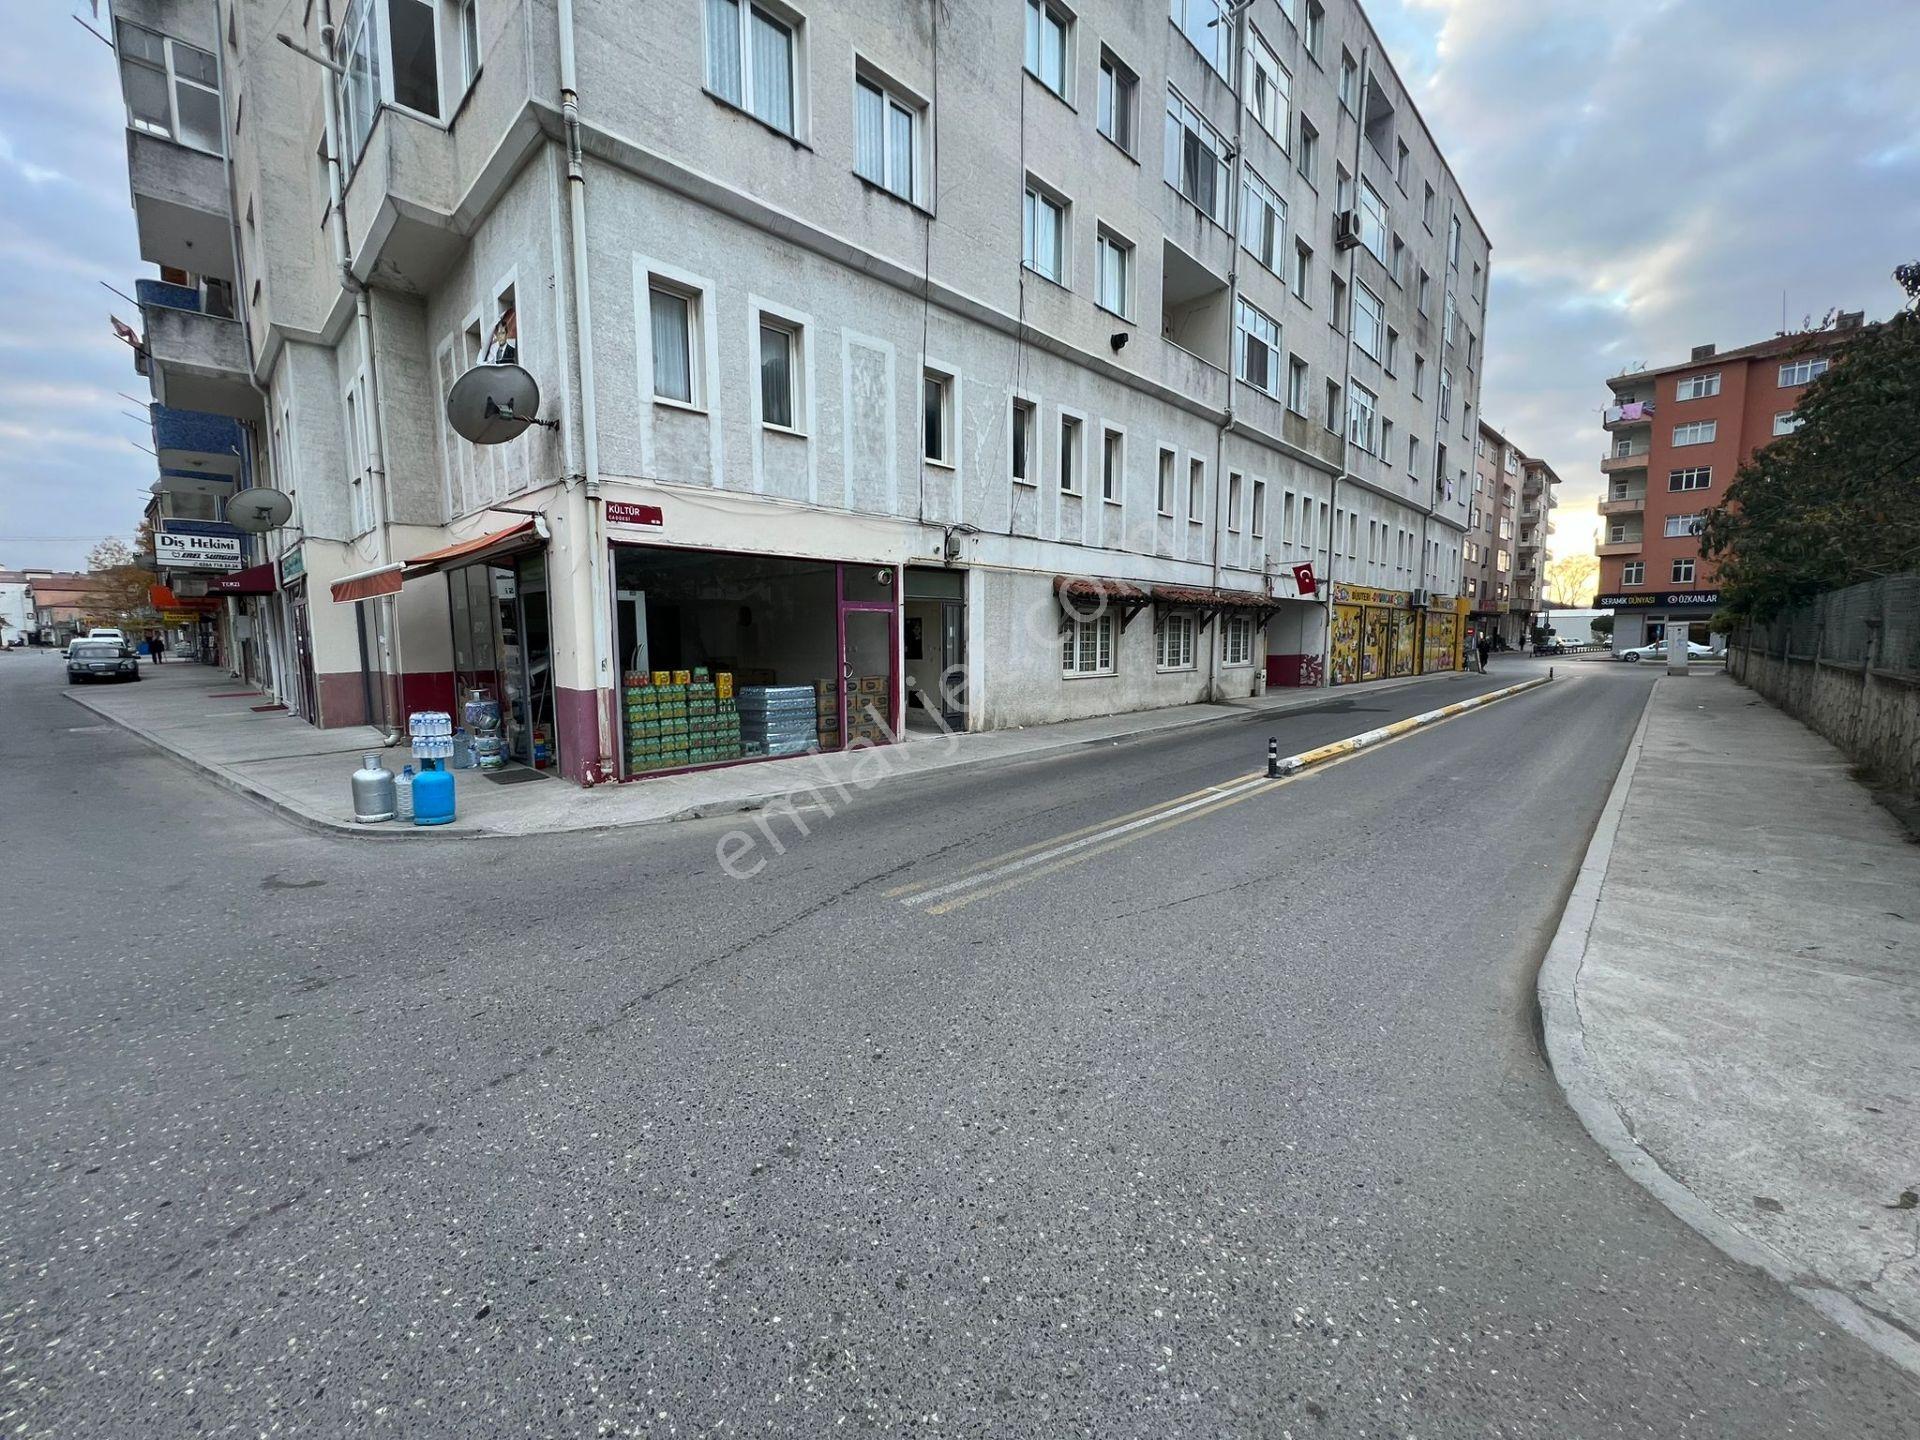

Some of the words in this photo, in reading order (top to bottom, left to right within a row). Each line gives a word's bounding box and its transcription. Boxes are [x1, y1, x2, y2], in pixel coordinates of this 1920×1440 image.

[608, 504, 640, 516] KÜLTÜR
[161, 536, 185, 550] Diş
[1678, 595, 1717, 604] ÖZKANLAR
